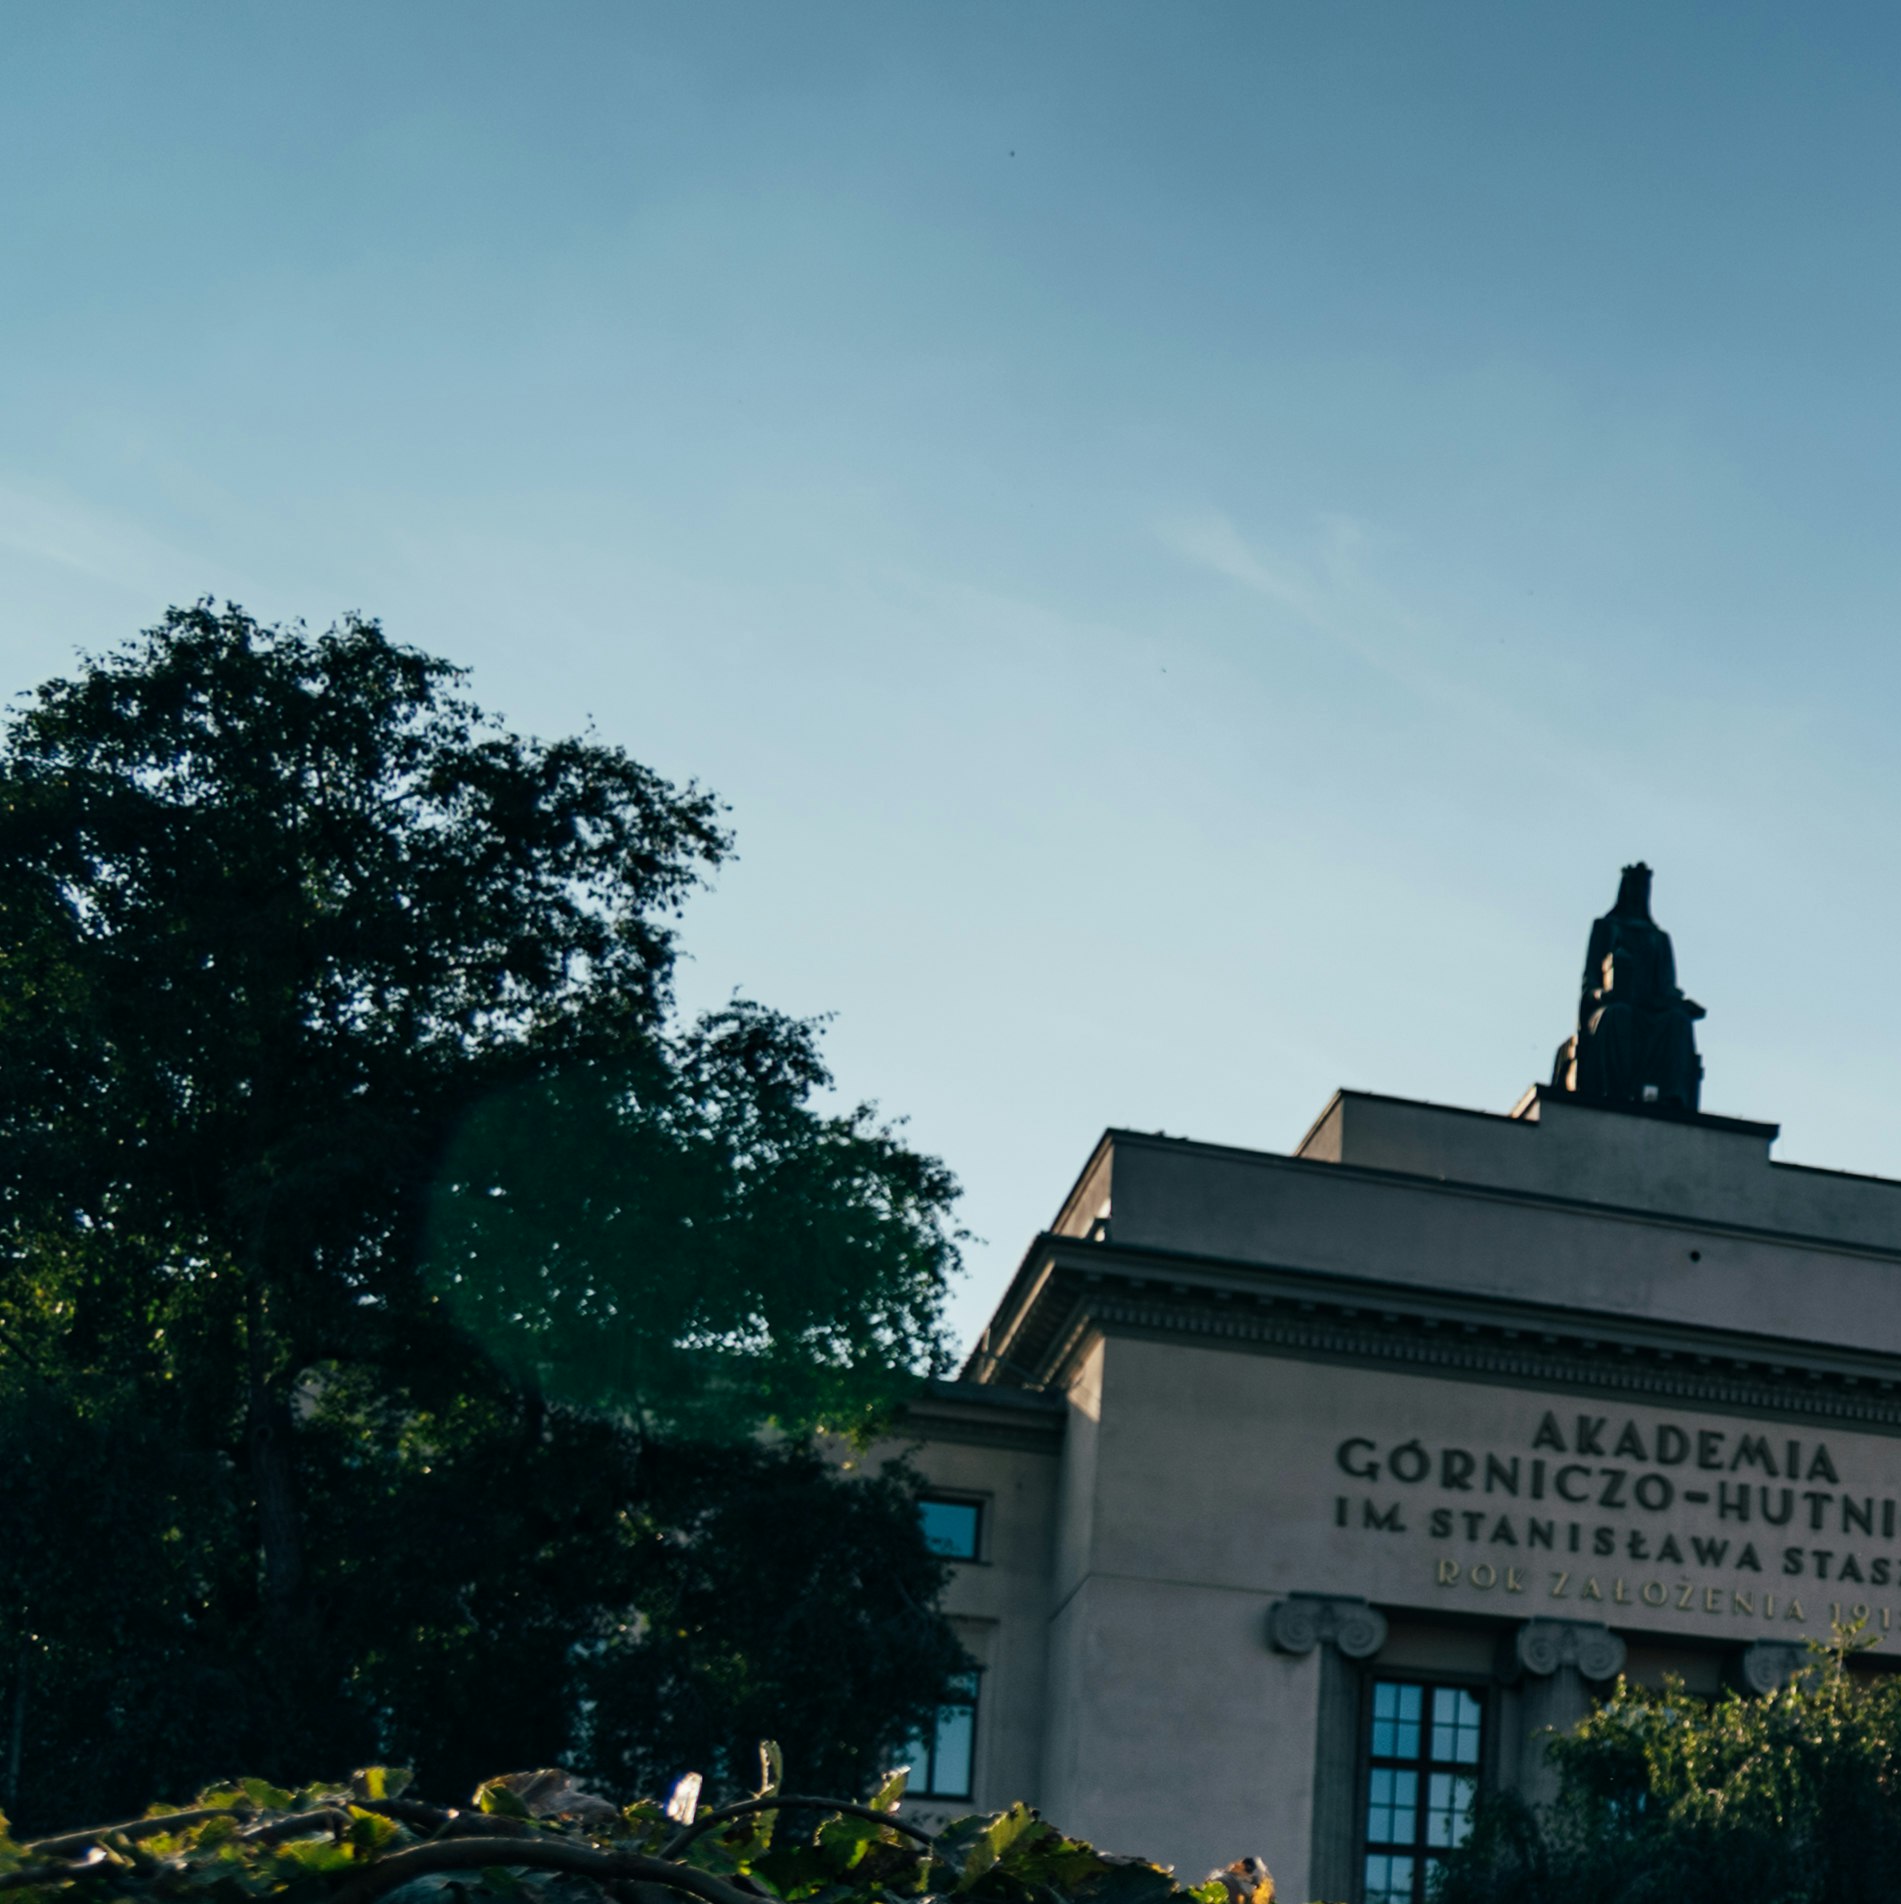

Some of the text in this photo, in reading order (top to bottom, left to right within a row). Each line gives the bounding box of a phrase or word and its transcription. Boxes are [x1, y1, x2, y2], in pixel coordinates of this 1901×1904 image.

[1532, 1410, 1840, 1485] AKADEMIA
[1429, 1507, 1763, 1574] STANISŁAWA
[1437, 1558, 1527, 1593] ROK
[1549, 1570, 1807, 1624] ZAŁOŻENIA
